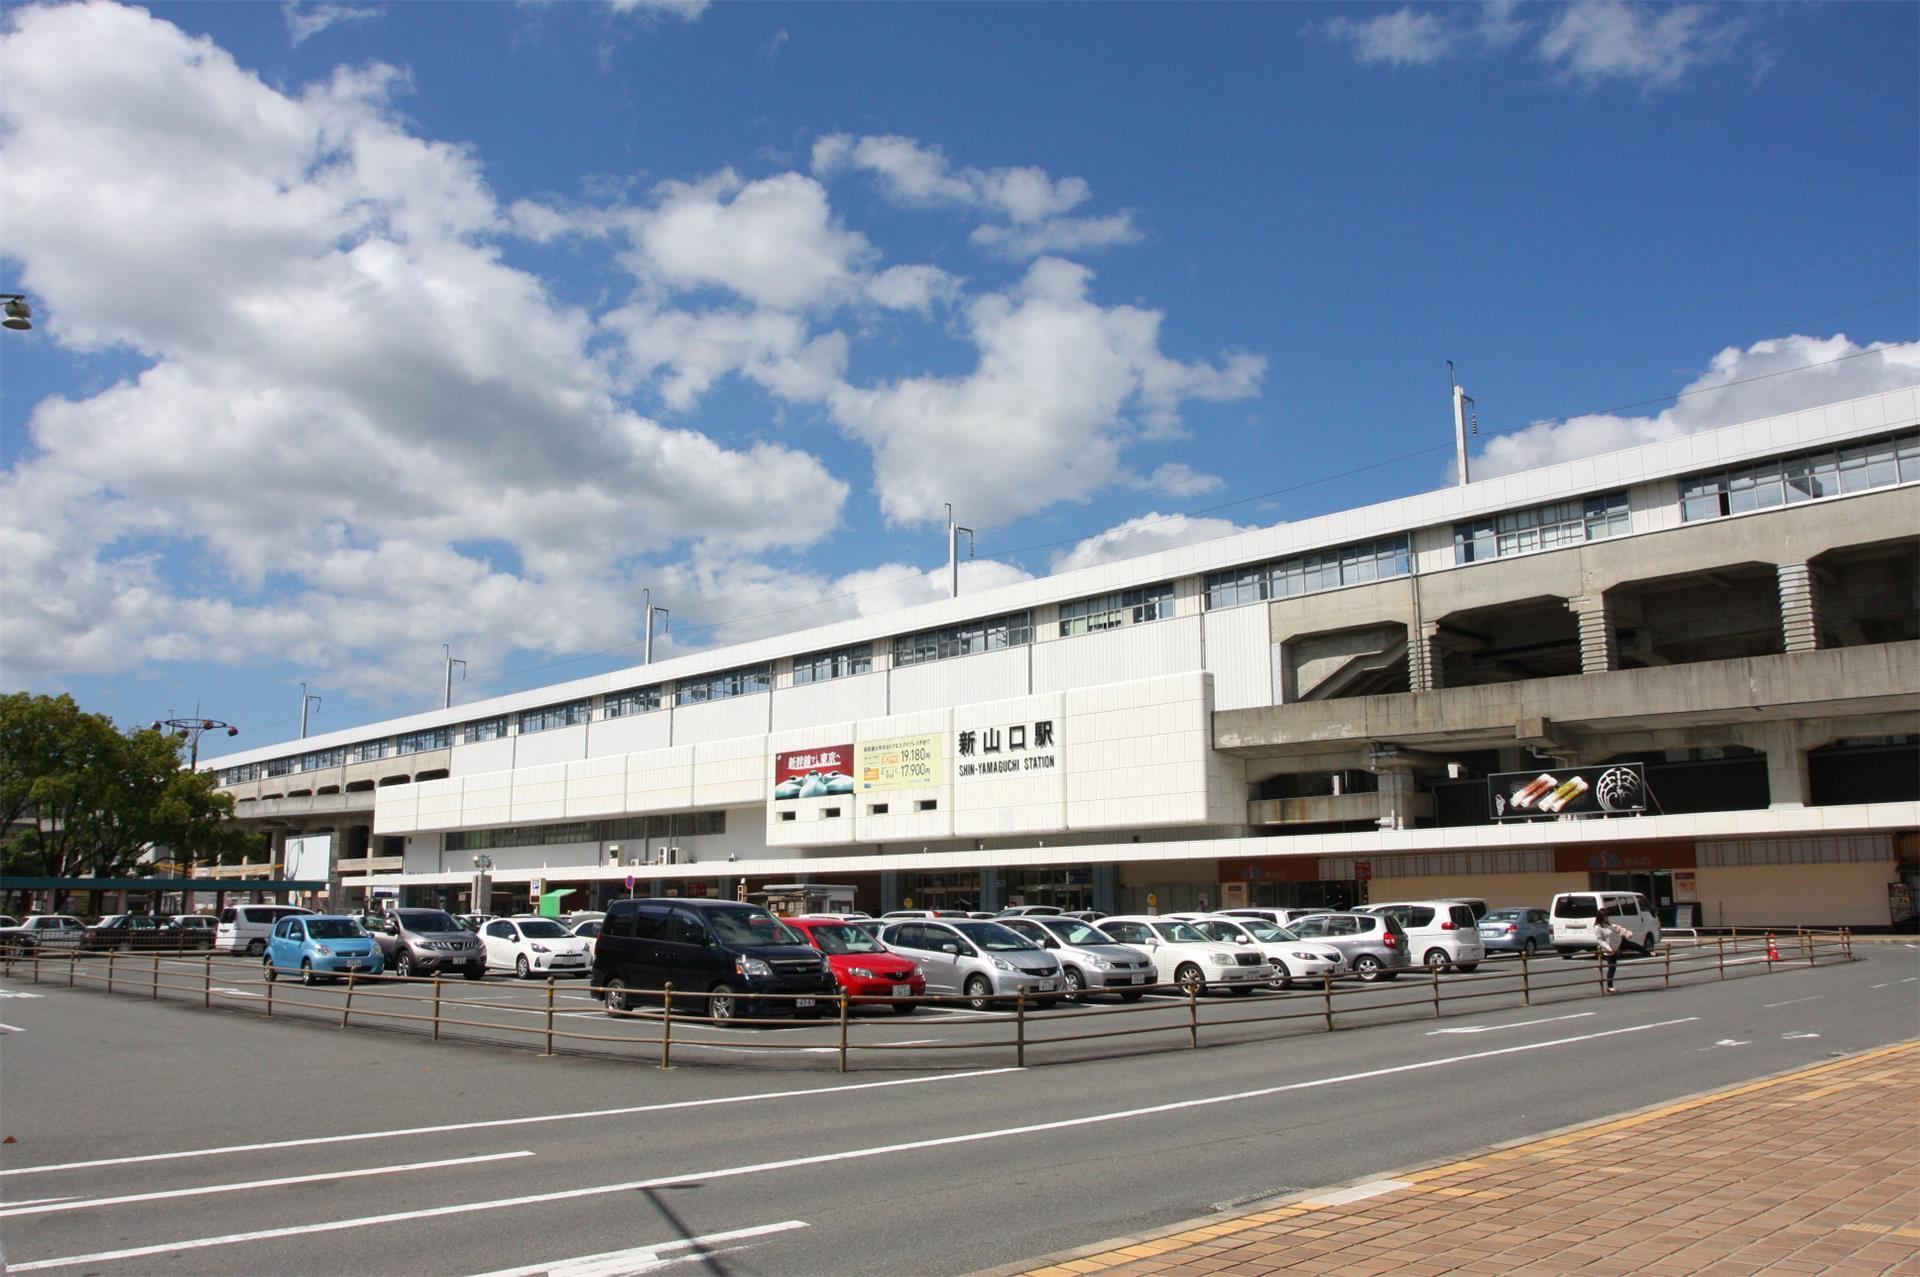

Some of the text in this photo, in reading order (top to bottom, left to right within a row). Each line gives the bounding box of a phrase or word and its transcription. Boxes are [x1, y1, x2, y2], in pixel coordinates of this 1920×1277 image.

[959, 720, 1054, 757] 新山口駅
[959, 755, 1055, 777] SHIN-YAMAGUCHI STATION
